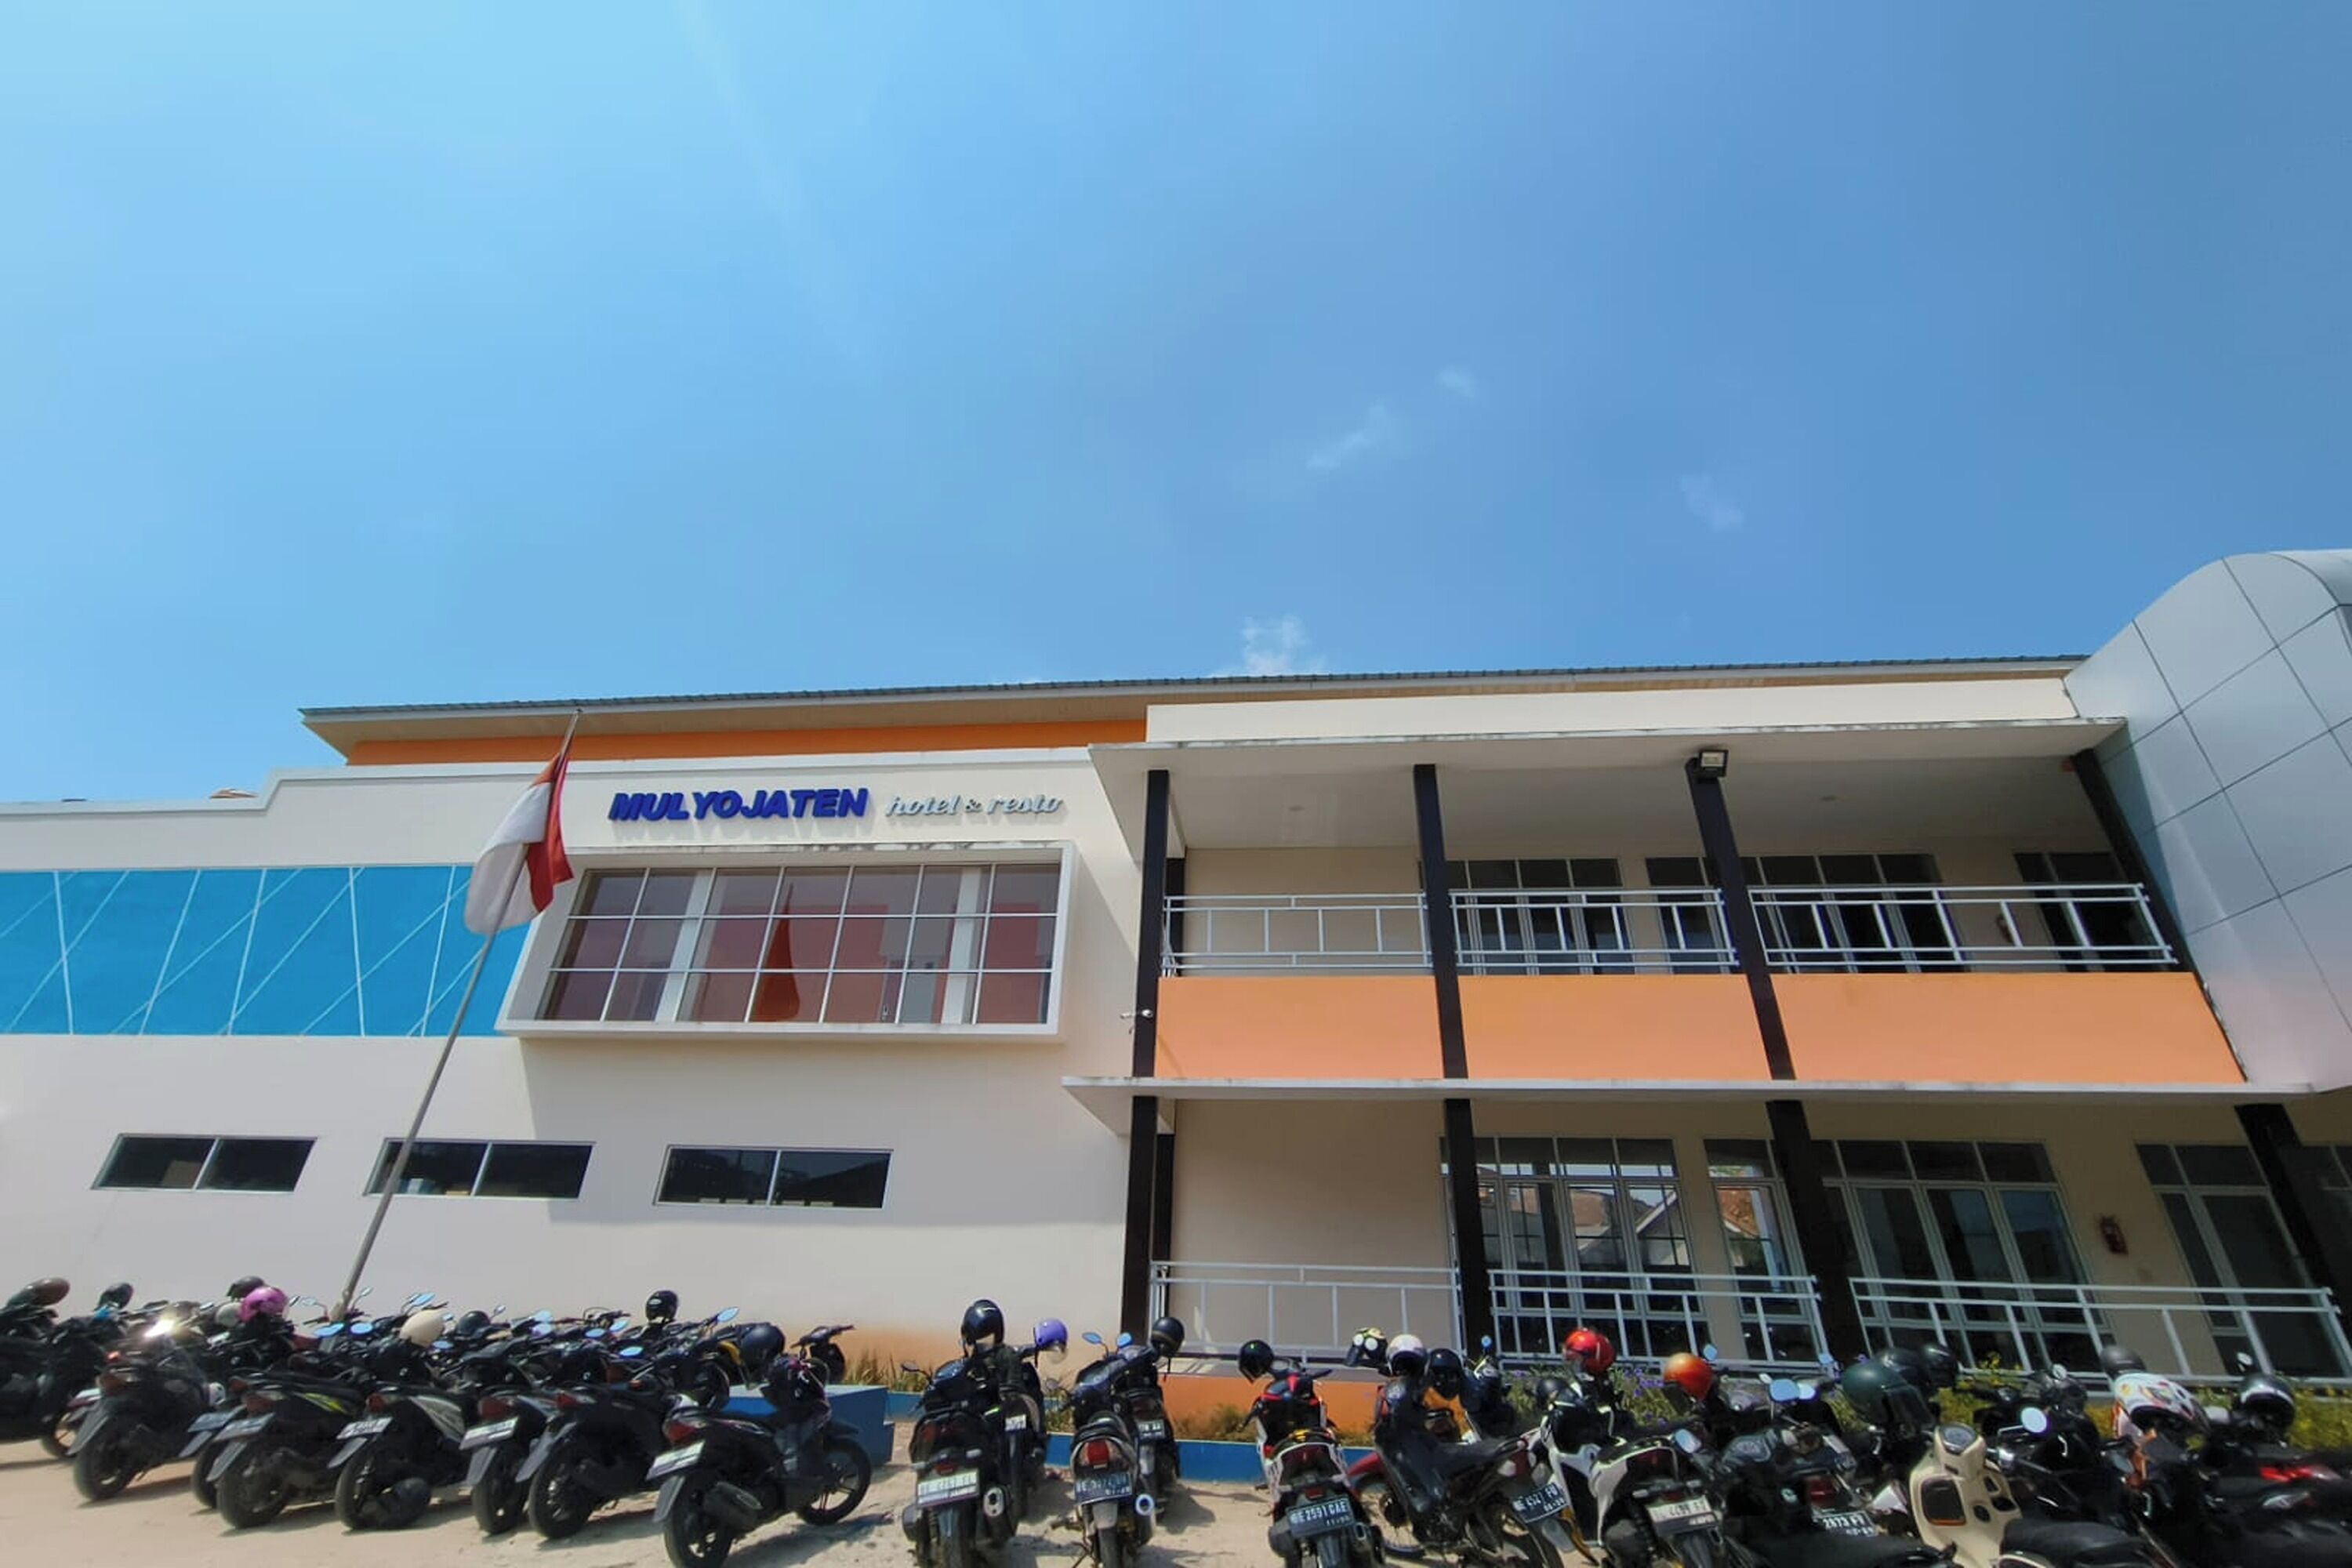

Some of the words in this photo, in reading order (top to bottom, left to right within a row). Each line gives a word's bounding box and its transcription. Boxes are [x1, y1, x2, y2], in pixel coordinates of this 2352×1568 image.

[608, 788, 869, 821] MULYOJATEN
[886, 795, 961, 816] hotel
[965, 799, 982, 813] &
[986, 794, 1063, 815] resto
